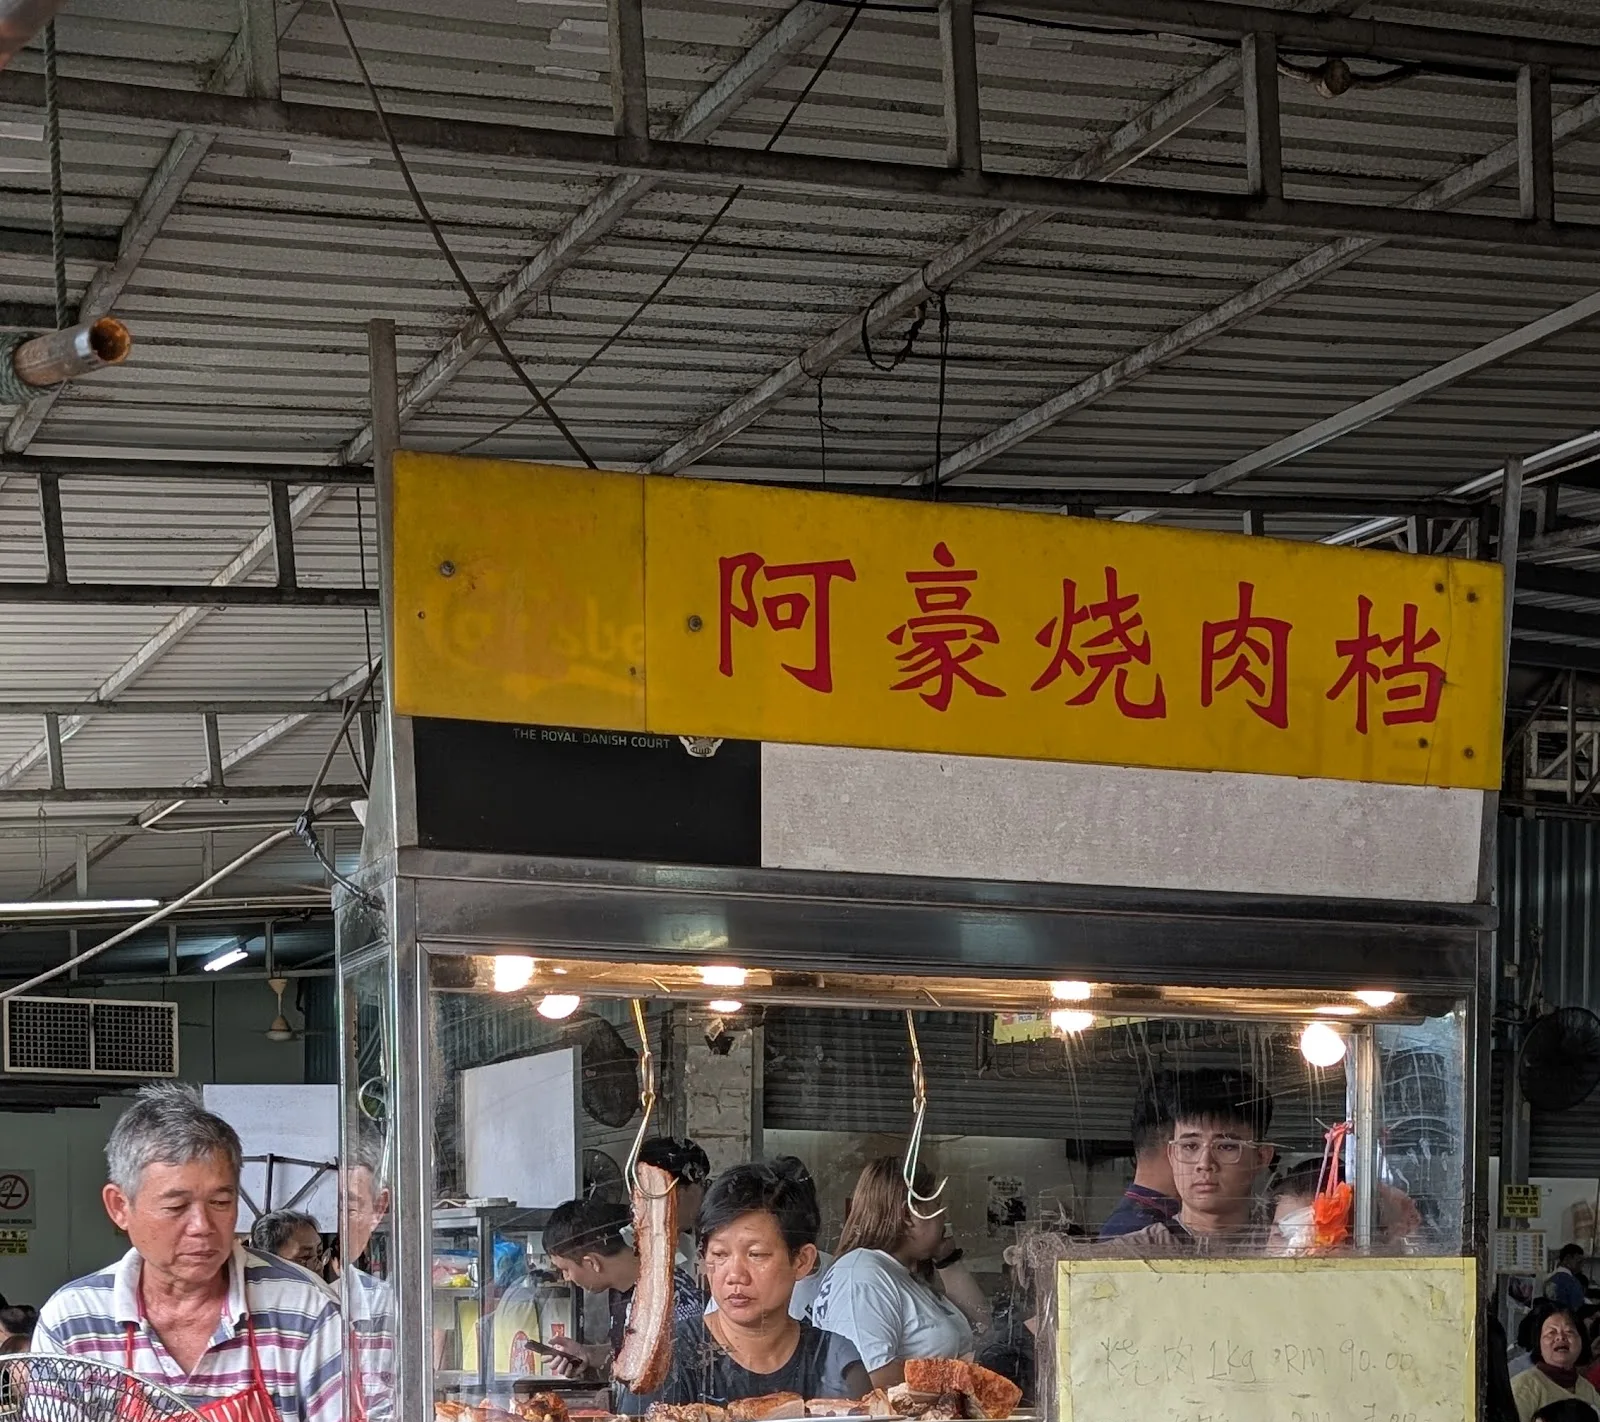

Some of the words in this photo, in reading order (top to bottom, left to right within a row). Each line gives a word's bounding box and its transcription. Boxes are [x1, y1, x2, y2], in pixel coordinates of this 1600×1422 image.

[718, 541, 1447, 735] 阿豪烧肉档
[513, 728, 537, 740] THE
[541, 731, 578, 743] ROYAL
[583, 733, 627, 746] DANISH
[631, 736, 670, 749] COURT
[1340, 1338, 1414, 1382] 90.00
